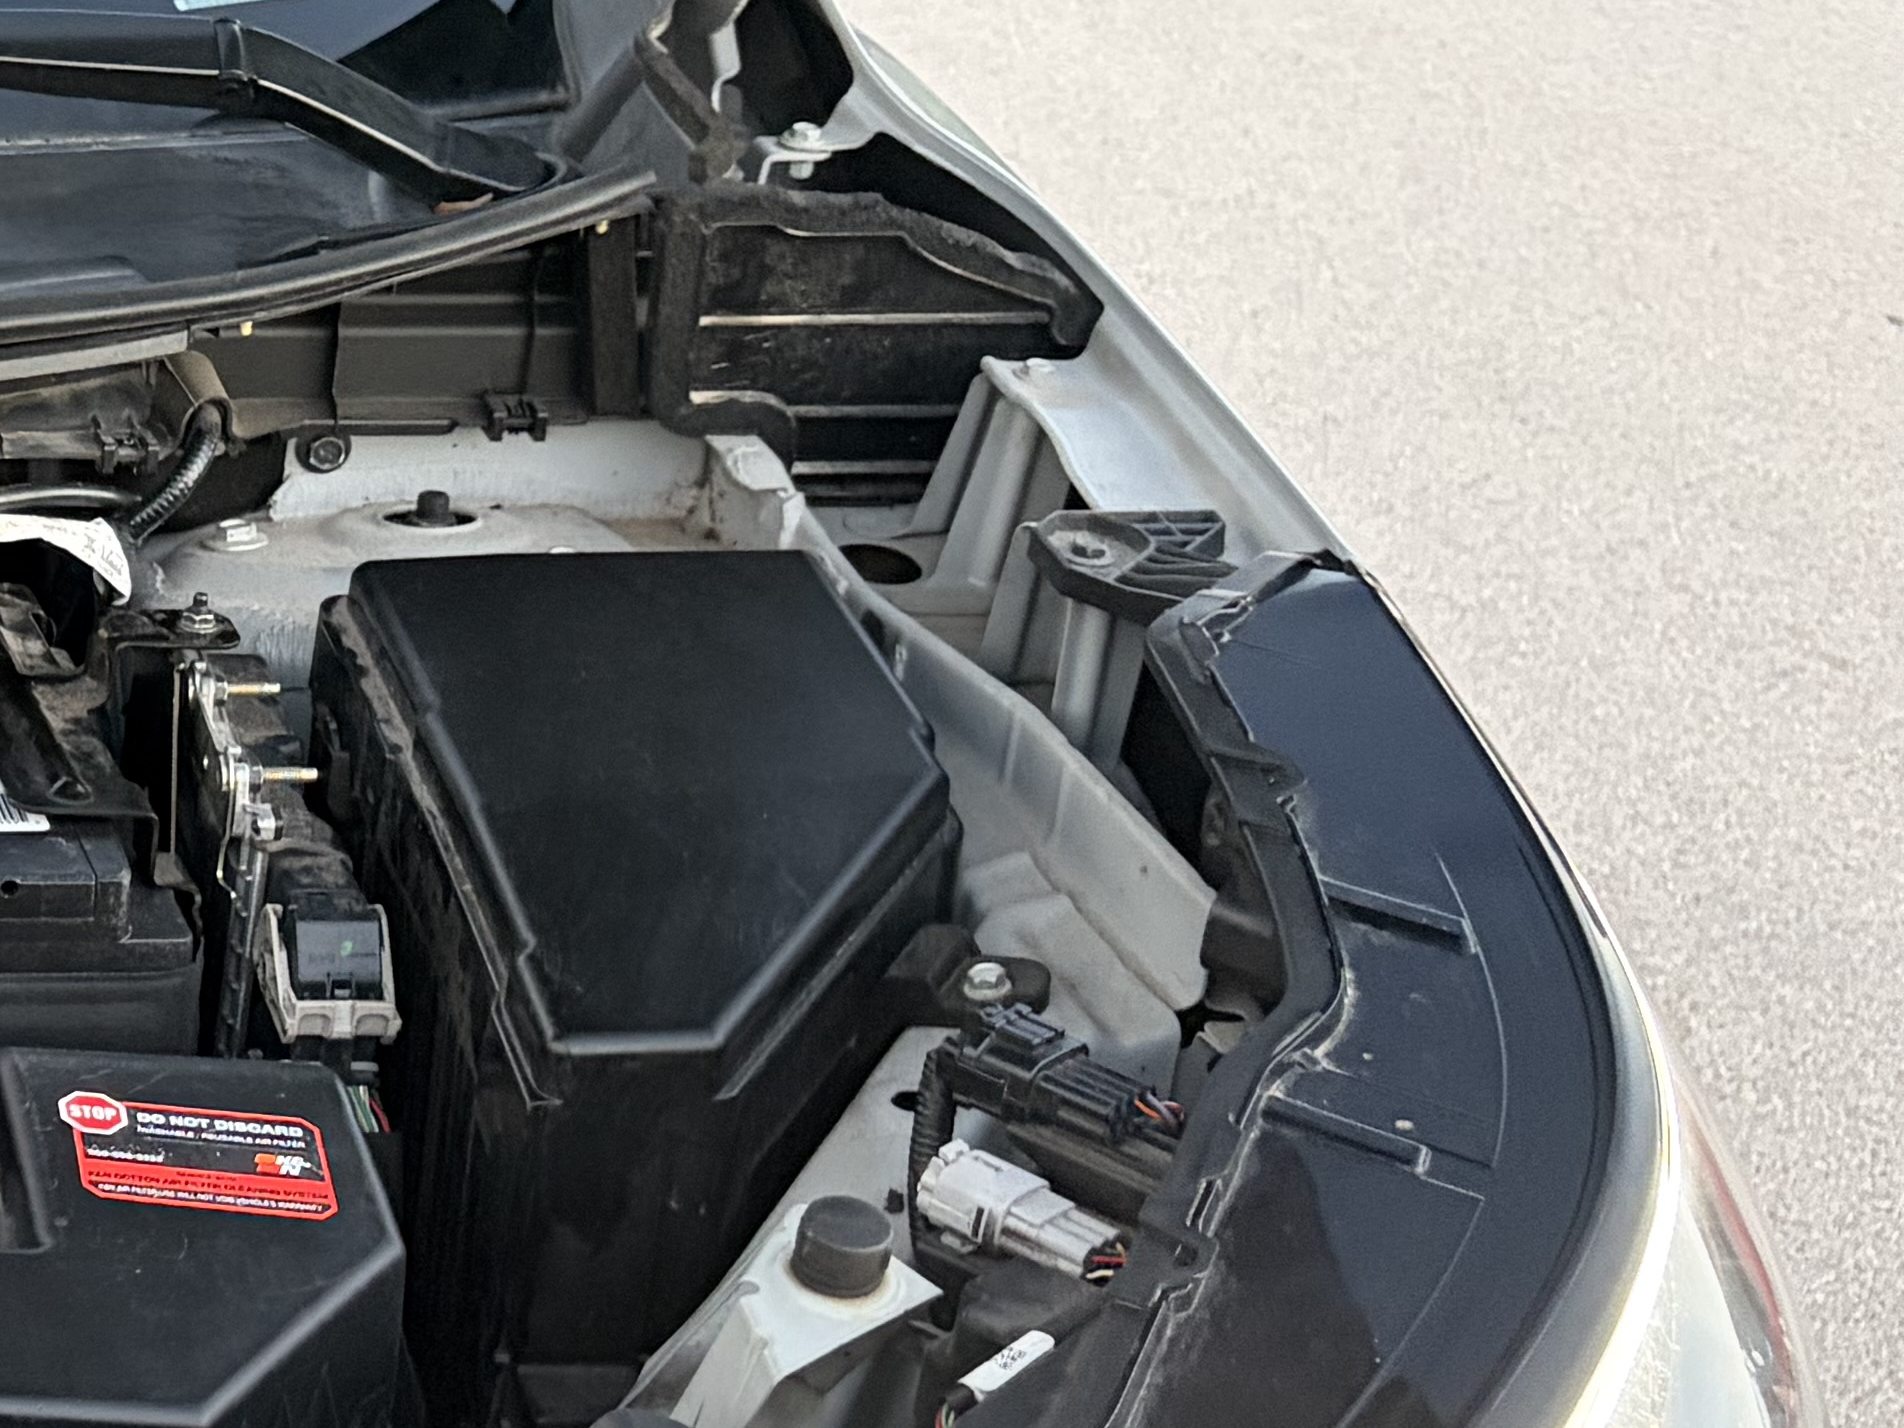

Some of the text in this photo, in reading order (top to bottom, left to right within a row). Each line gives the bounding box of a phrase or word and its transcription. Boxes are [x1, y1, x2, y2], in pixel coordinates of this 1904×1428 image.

[69, 1104, 117, 1121] STOP
[136, 1112, 304, 1138] DO NOT DISCARD
